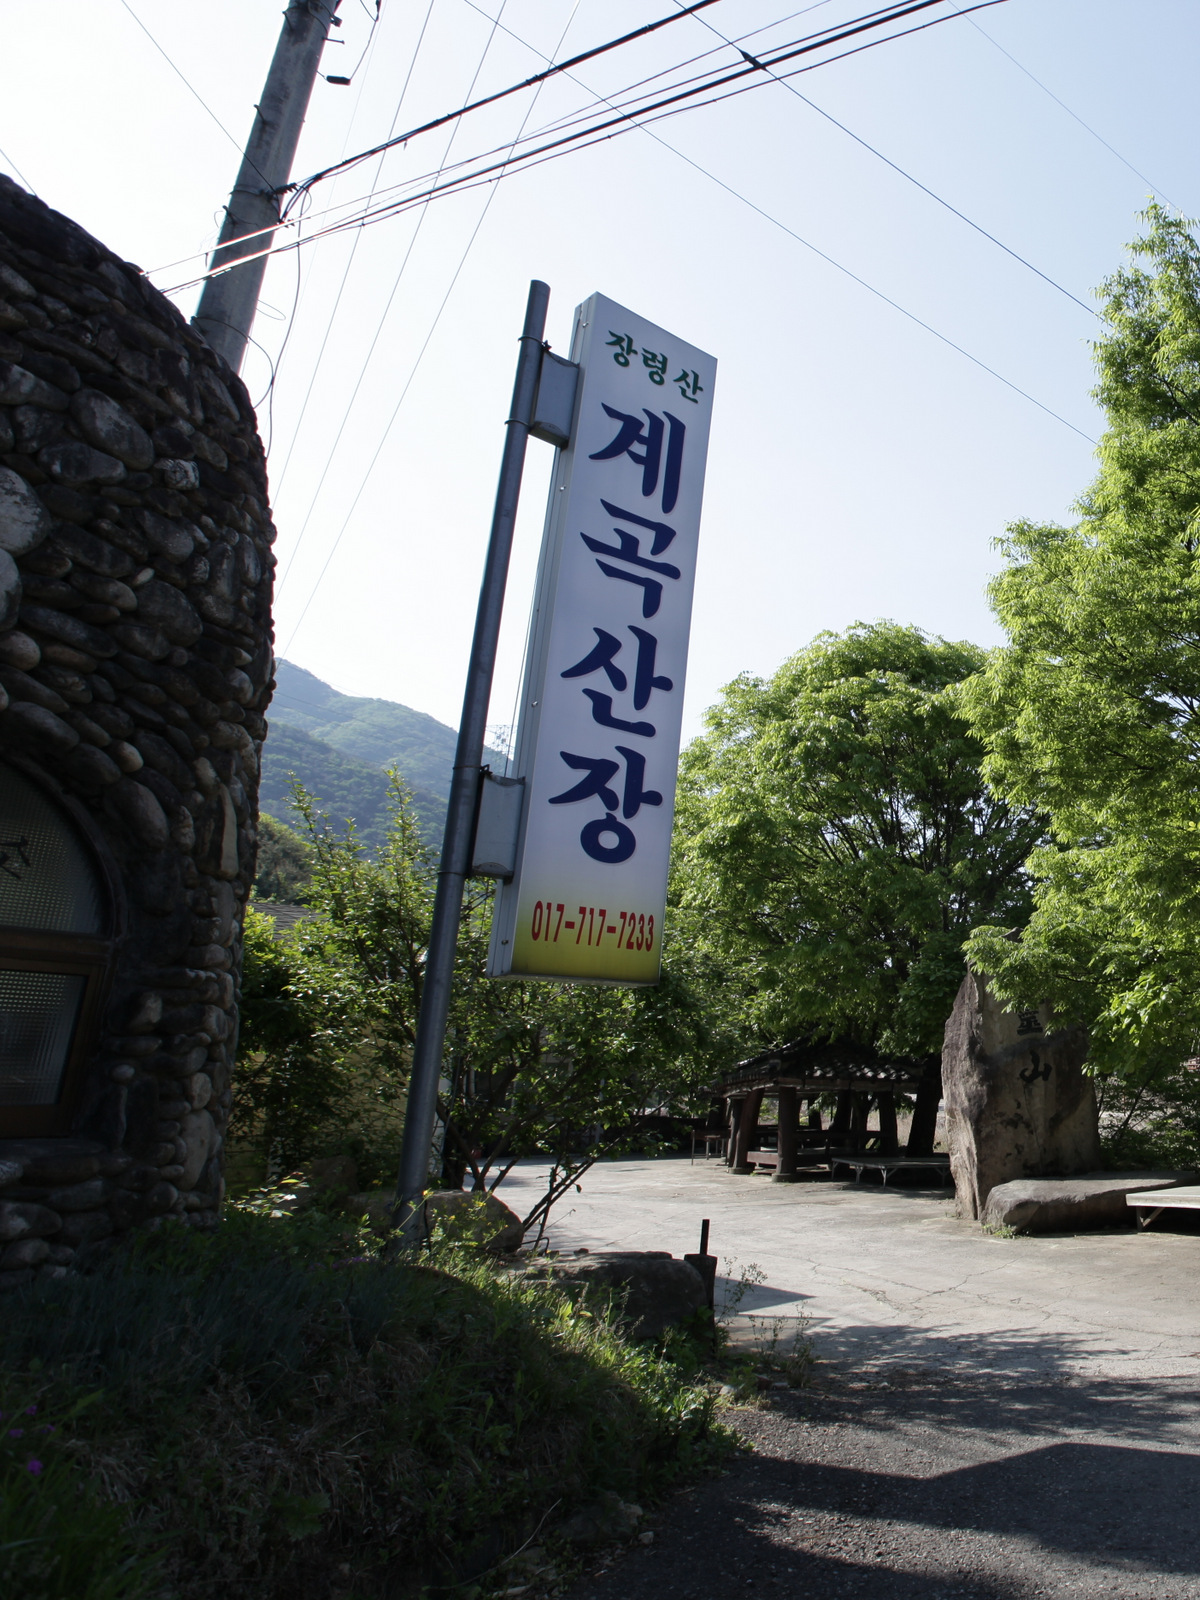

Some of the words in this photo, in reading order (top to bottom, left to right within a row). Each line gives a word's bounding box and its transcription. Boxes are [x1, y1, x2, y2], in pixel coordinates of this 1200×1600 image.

[604, 329, 704, 405] 장령산
[547, 401, 688, 864] 계곡산장
[530, 899, 655, 953] 017-717-7233
